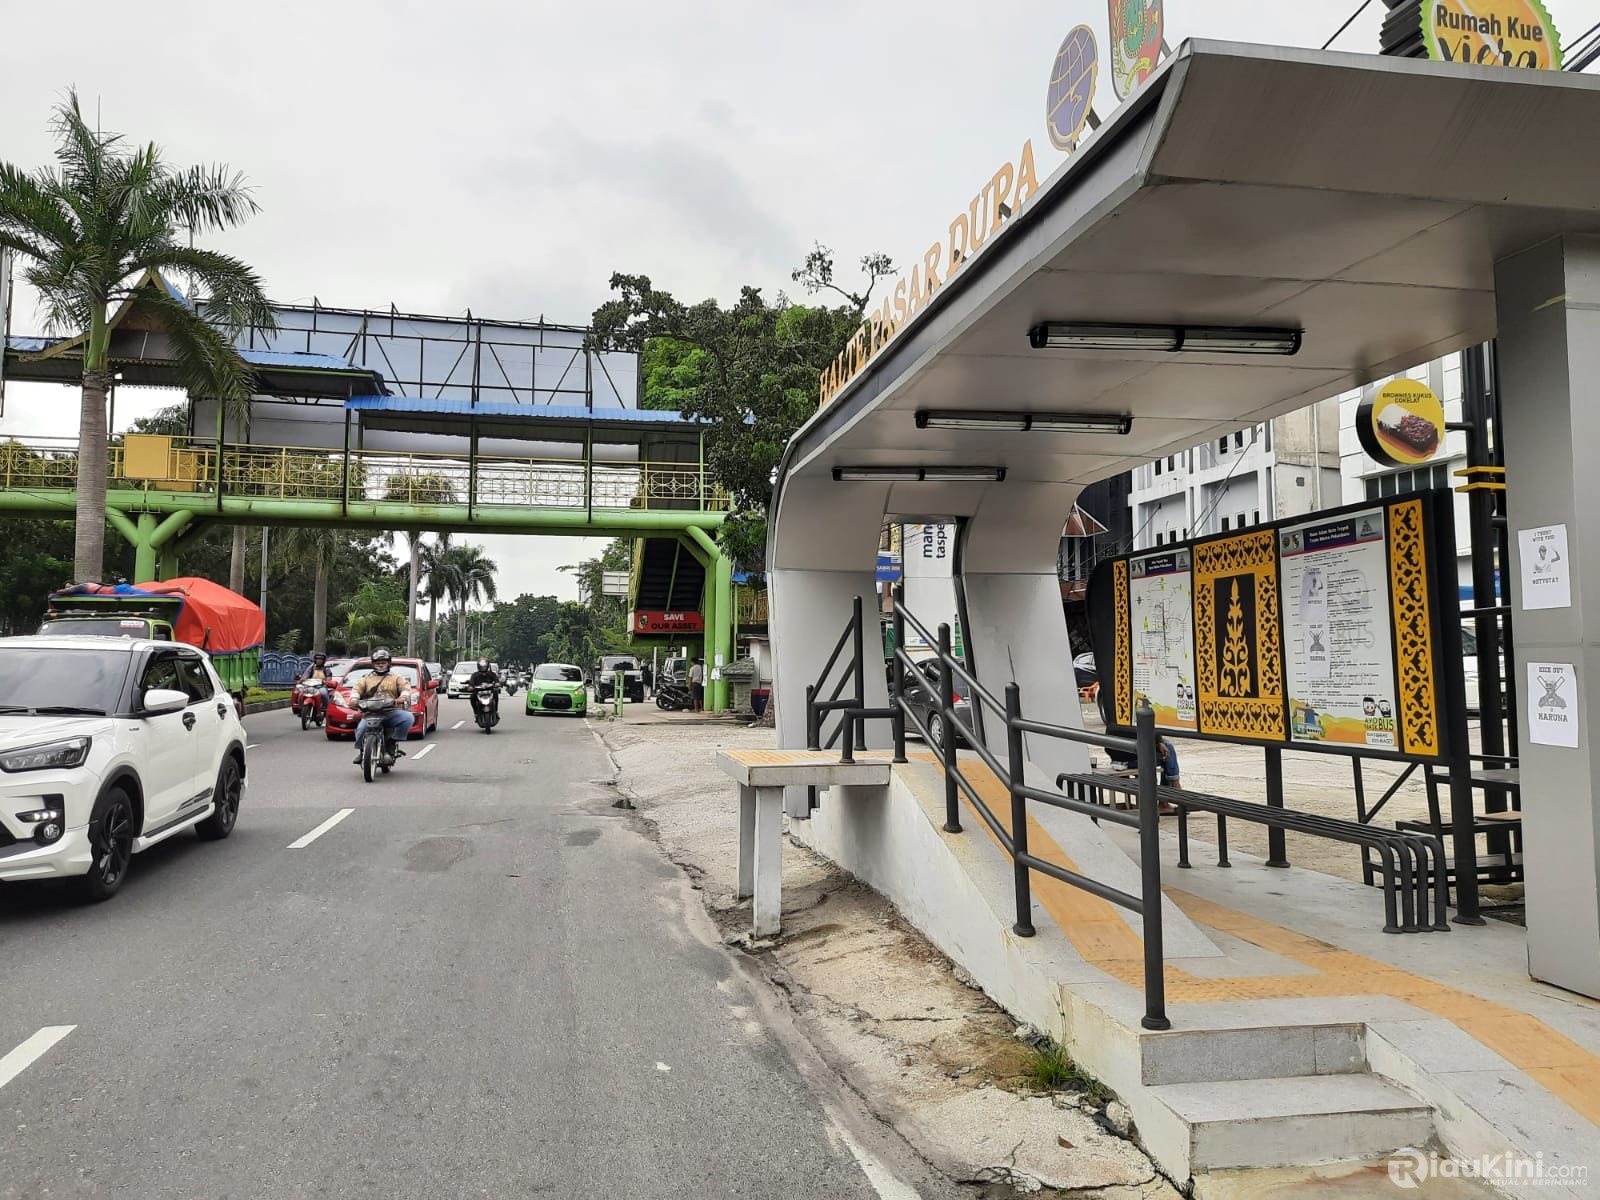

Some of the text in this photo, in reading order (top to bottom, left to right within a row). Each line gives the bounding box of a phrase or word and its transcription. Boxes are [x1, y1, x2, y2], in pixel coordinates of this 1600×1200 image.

[1436, 4, 1544, 42] Rumah Kue
[818, 323, 867, 408] HALTE
[869, 241, 942, 357] PASAR
[923, 523, 933, 558] man
[663, 613, 684, 621] SAVE
[1378, 718, 1394, 731] BUS
[1538, 713, 1568, 722] HARUNA
